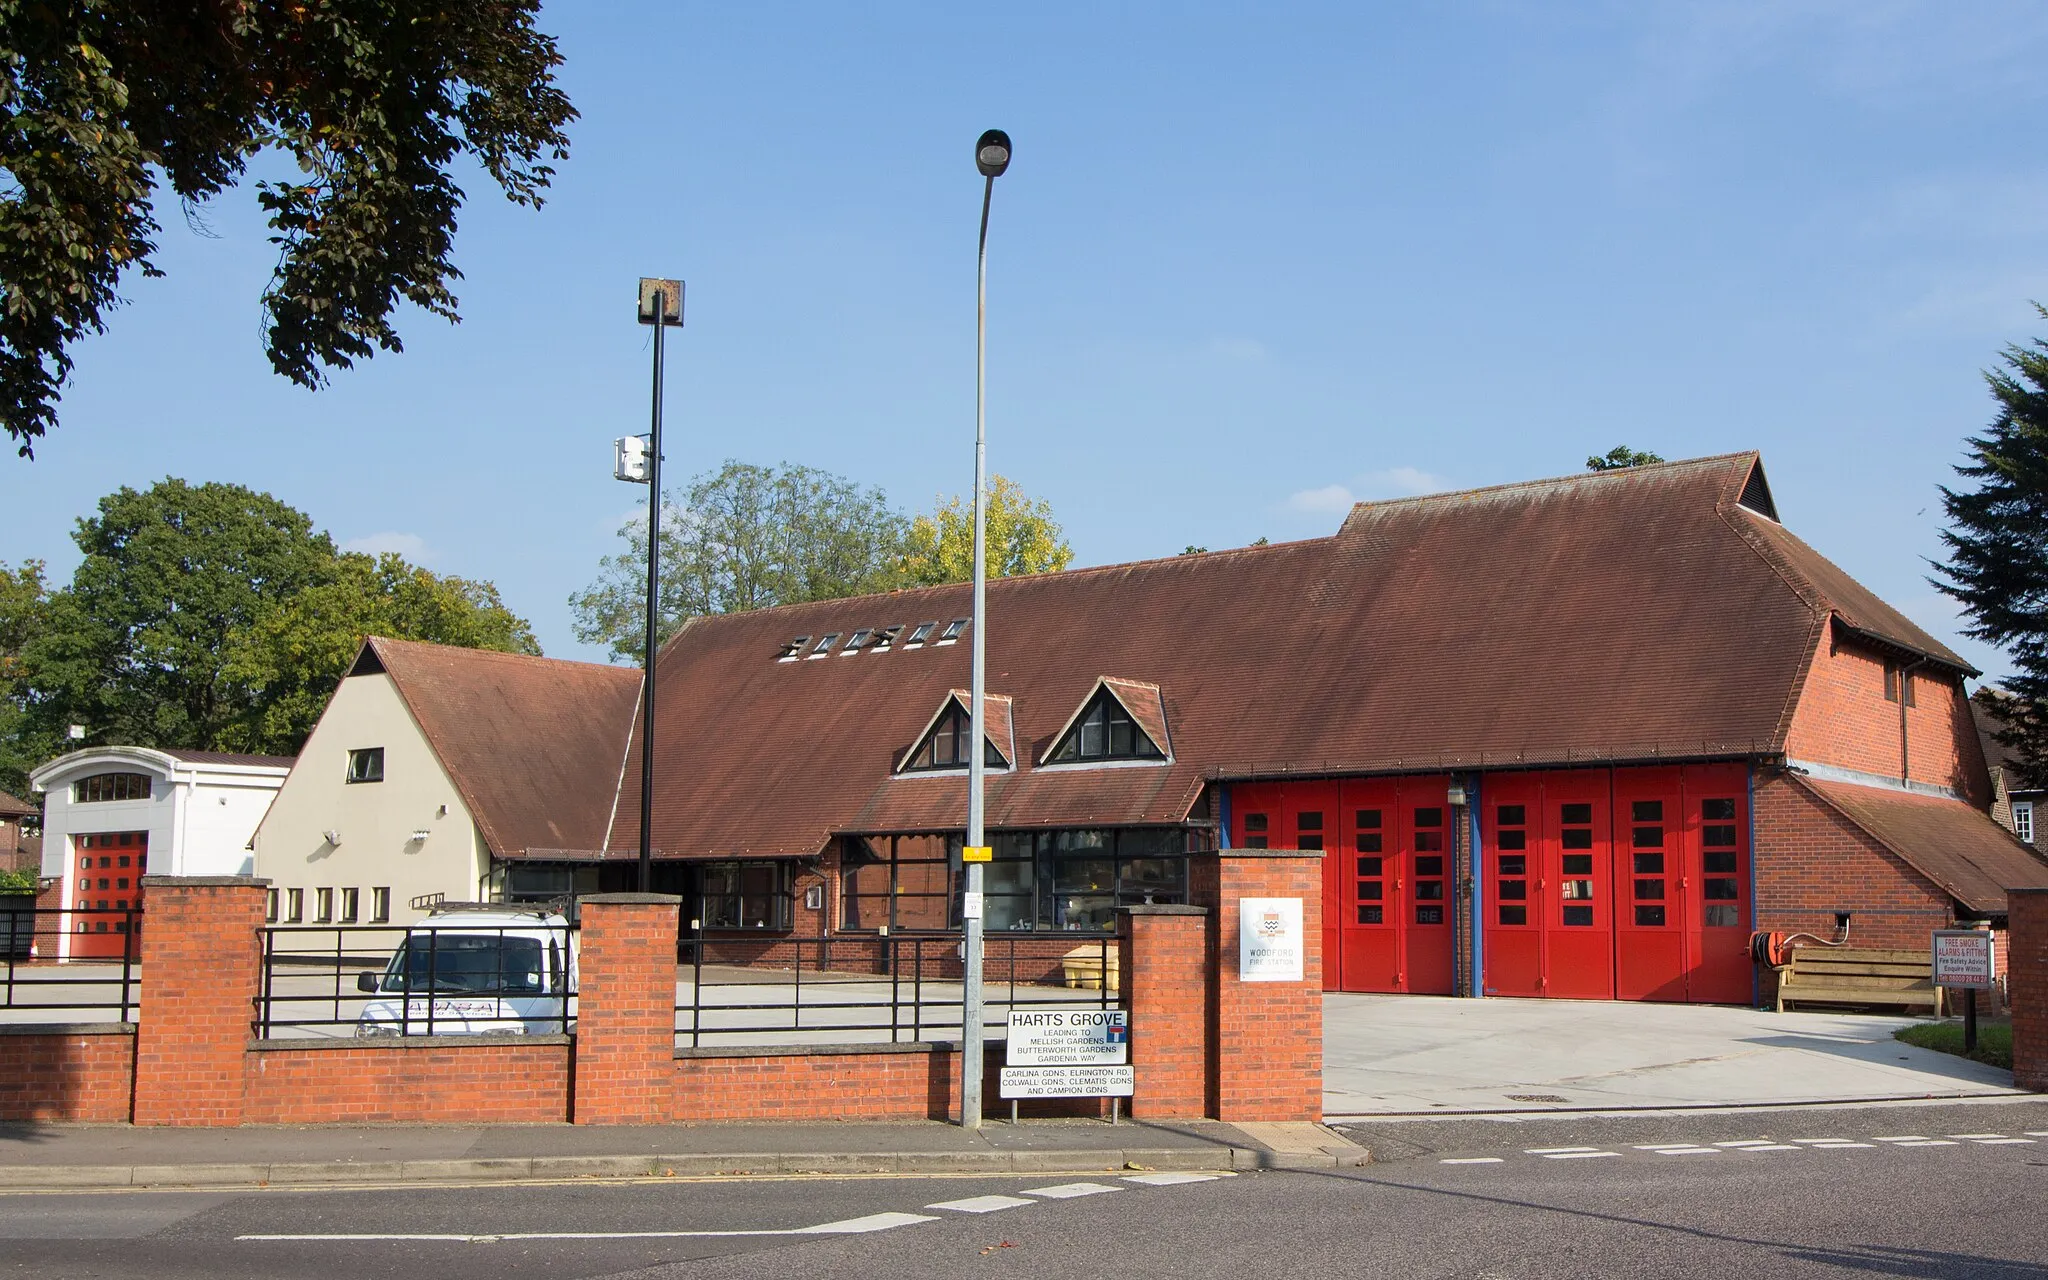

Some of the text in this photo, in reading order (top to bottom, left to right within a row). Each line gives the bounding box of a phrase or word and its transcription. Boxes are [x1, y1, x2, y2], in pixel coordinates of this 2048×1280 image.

[1945, 938, 1979, 948] FREE SMOKE
[1250, 948, 1294, 957] WOODFORD
[1938, 948, 1960, 956] ALARMS
[1012, 1014, 1122, 1026] HARTS GROVE
